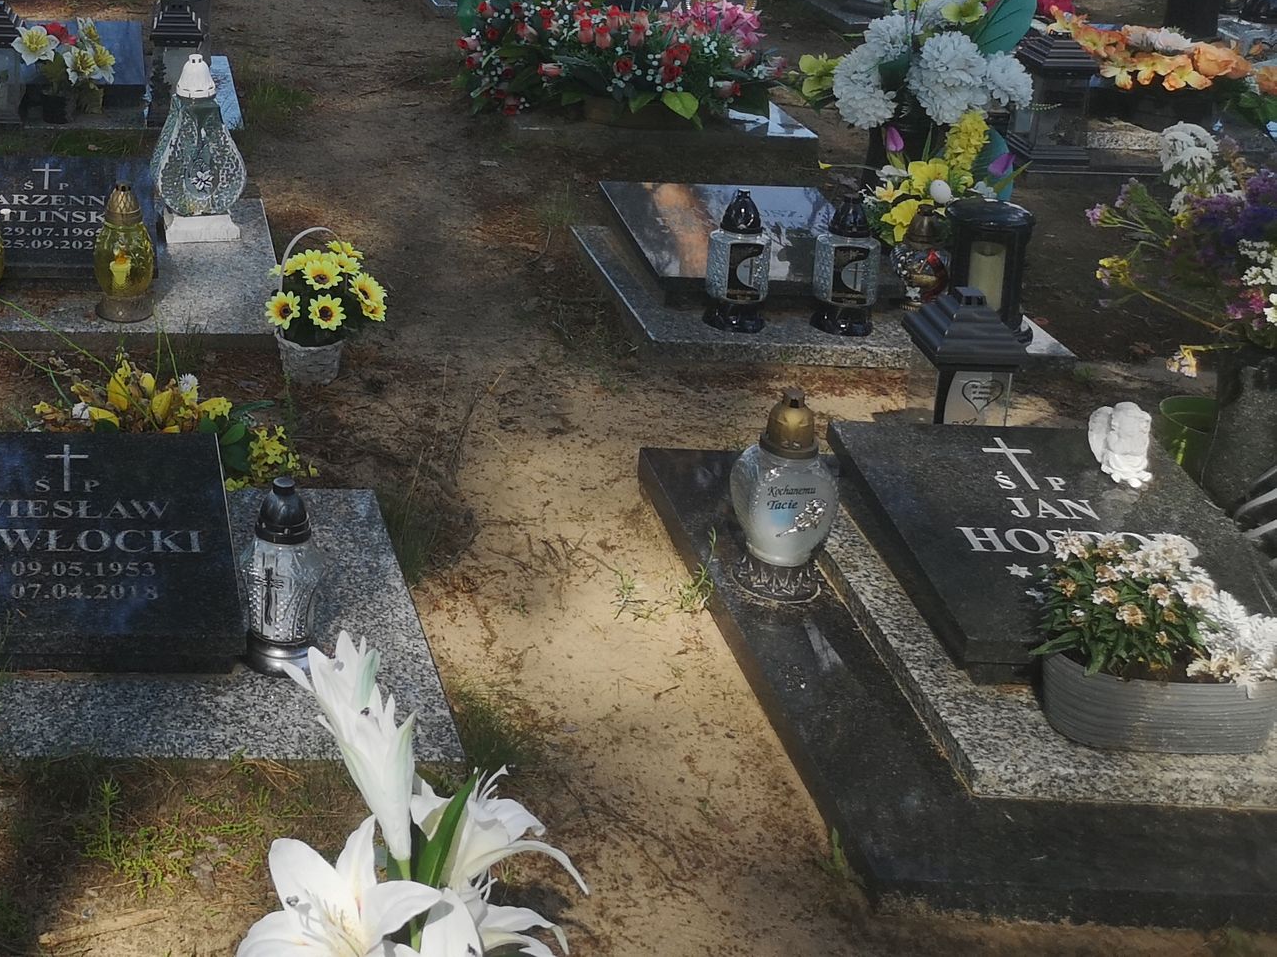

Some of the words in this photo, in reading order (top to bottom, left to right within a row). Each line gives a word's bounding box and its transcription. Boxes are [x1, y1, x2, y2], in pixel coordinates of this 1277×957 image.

[23, 180, 34, 191] Ś
[59, 182, 70, 191] P
[2, 239, 94, 250] 25.09.202
[35, 476, 51, 493] Ś
[84, 479, 100, 493] P
[994, 470, 1018, 490] Ś
[1043, 476, 1067, 491] P
[1006, 497, 1101, 521] JAN
[10, 560, 157, 578] 09.05.1953
